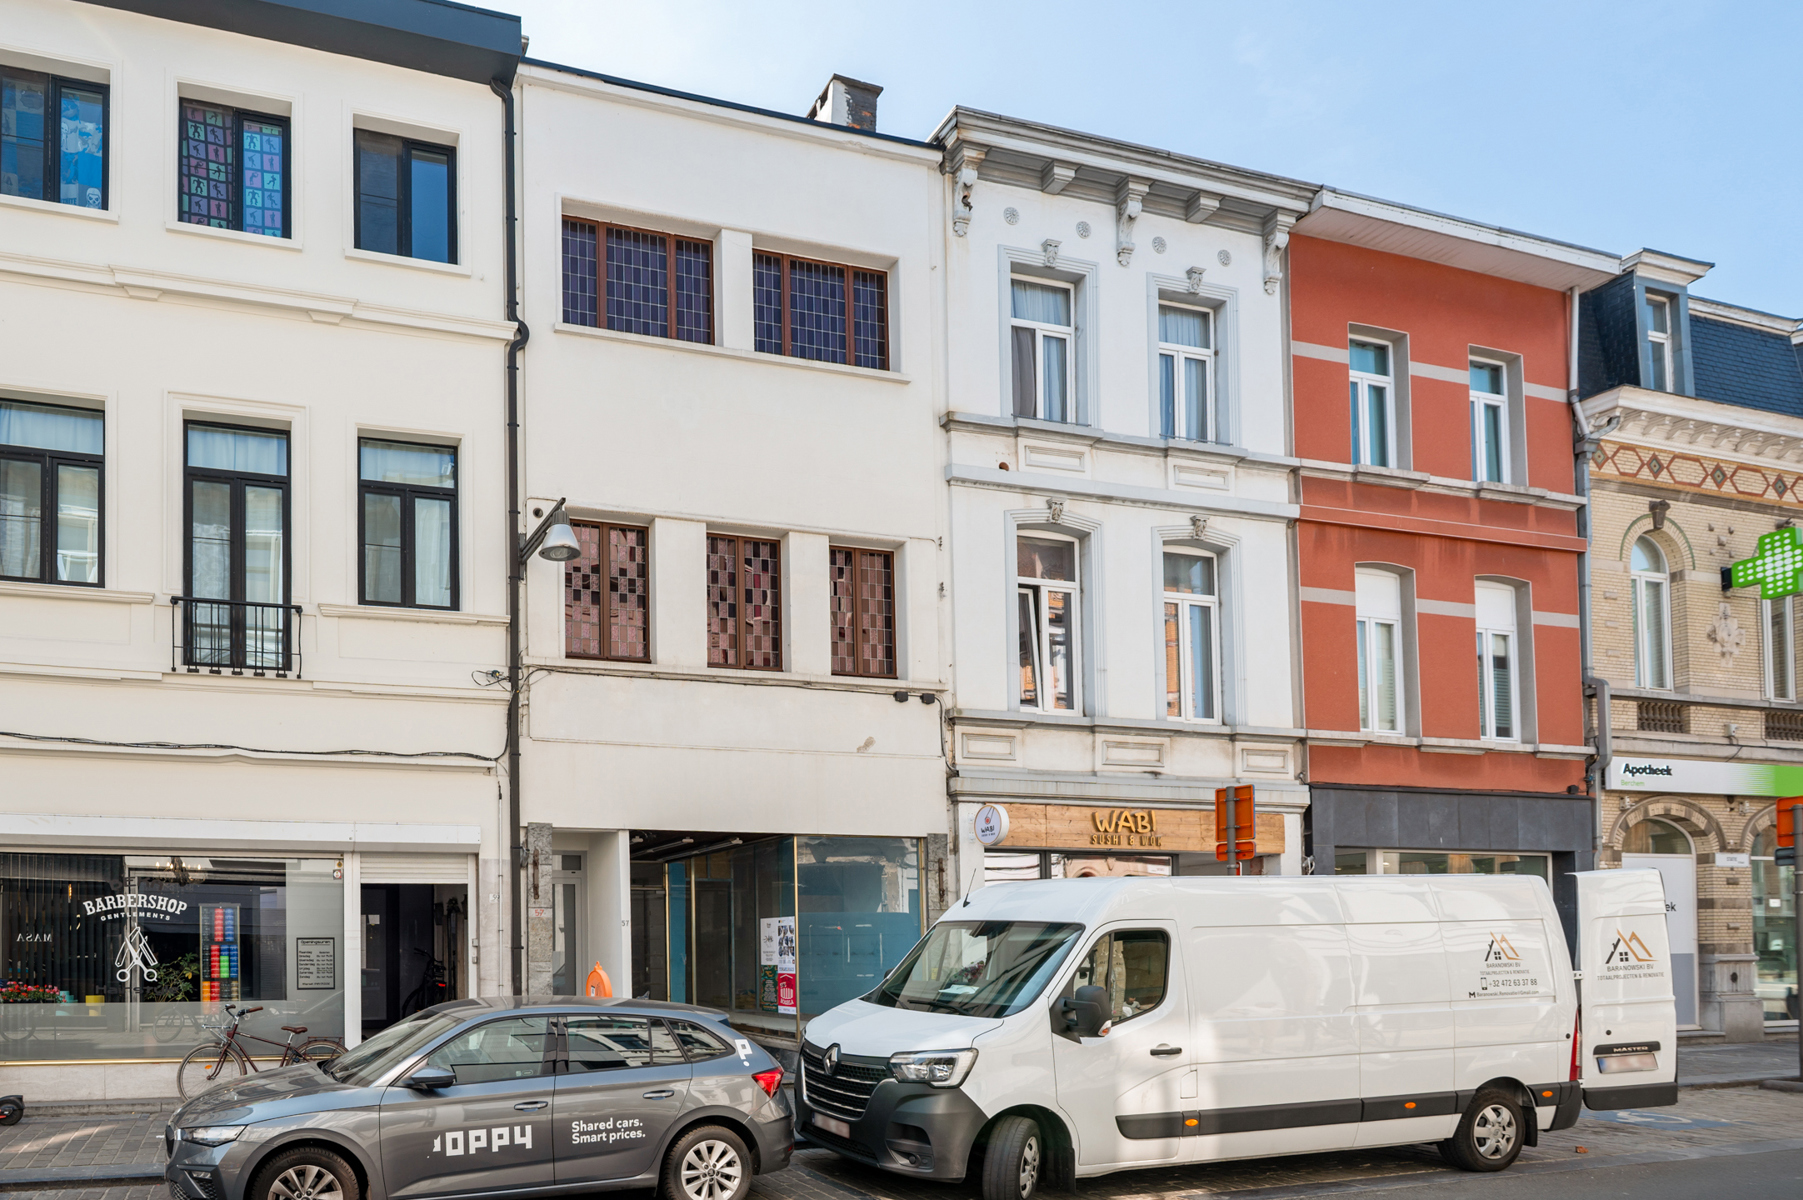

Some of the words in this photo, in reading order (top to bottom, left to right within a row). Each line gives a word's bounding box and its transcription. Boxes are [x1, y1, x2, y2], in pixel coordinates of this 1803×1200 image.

[1623, 763, 1672, 777] Apotheek
[1621, 779, 1645, 787] Berchem
[1092, 810, 1157, 833] WABI
[1090, 834, 1123, 846] SUSHI
[1128, 835, 1135, 846] &
[1140, 835, 1162, 847] WOK
[83, 893, 188, 916] BARBERSHOP
[100, 911, 171, 921] GENTLEMENTS
[534, 909, 545, 917] 57
[621, 919, 630, 927] 57
[1607, 964, 1646, 972] BARANOWSKI
[1488, 979, 1500, 987] +32
[1501, 979, 1512, 987] 472
[1522, 978, 1529, 986] 37
[1530, 978, 1538, 986] 88
[571, 1118, 613, 1132] Shared
[616, 1117, 643, 1129] cars.
[571, 1131, 607, 1144] Smart
[609, 1128, 646, 1144] prices.
